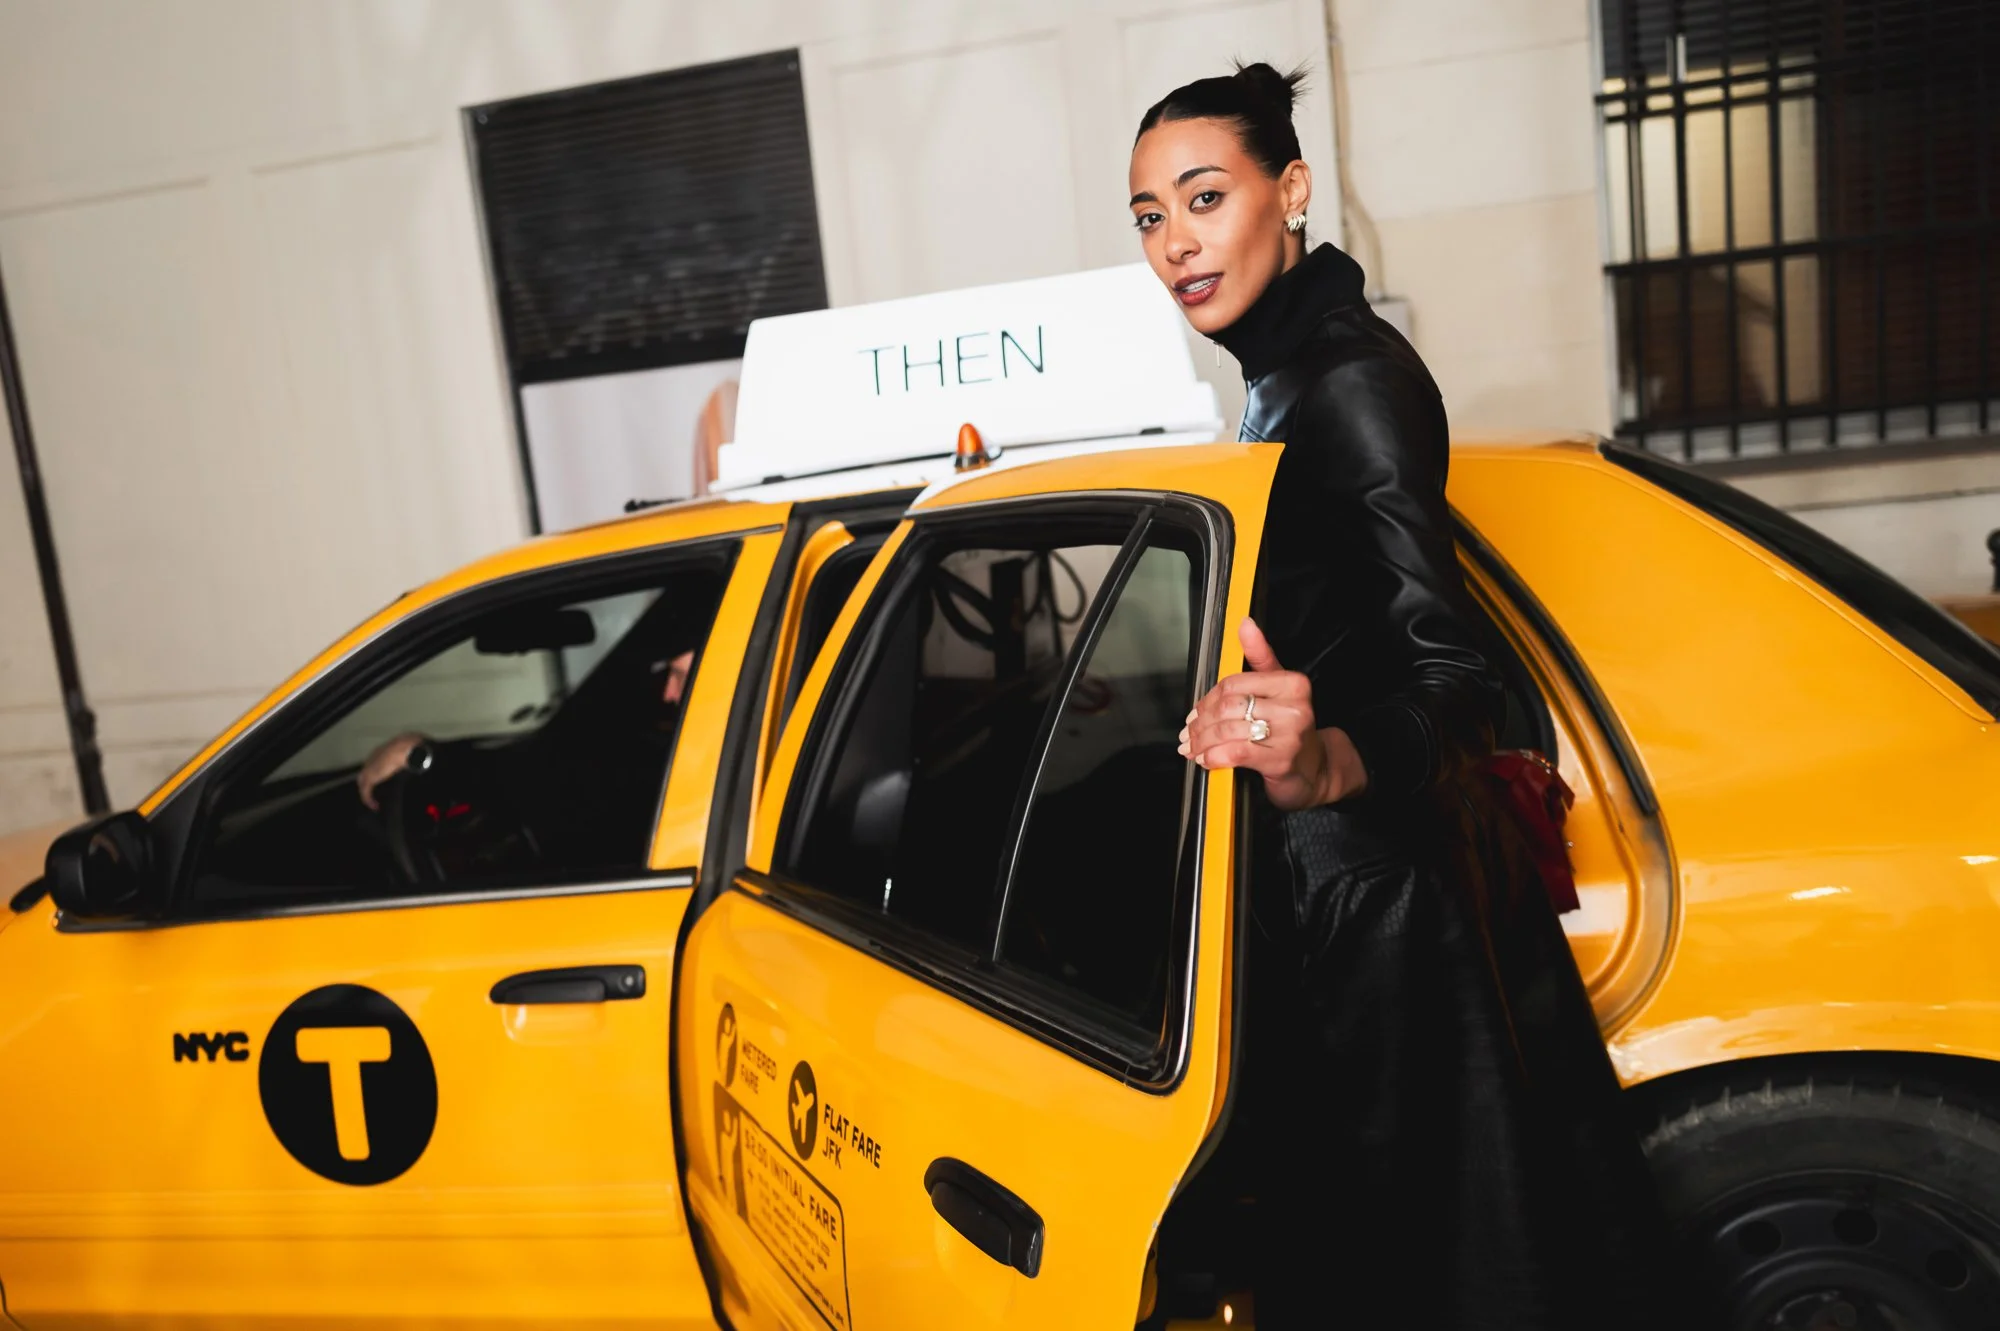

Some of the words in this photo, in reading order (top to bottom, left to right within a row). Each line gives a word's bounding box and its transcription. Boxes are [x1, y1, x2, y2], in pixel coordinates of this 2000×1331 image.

[858, 325, 1043, 395] THEN
[741, 1063, 759, 1095] FARE
[742, 1037, 777, 1081] METERED
[173, 1031, 249, 1062] NYC
[295, 1026, 392, 1161] T
[822, 1136, 841, 1169] JFK
[823, 1103, 849, 1140] FLAT
[851, 1125, 881, 1169] FARE
[770, 1154, 805, 1208] INITIAL
[810, 1195, 836, 1241] FARE
